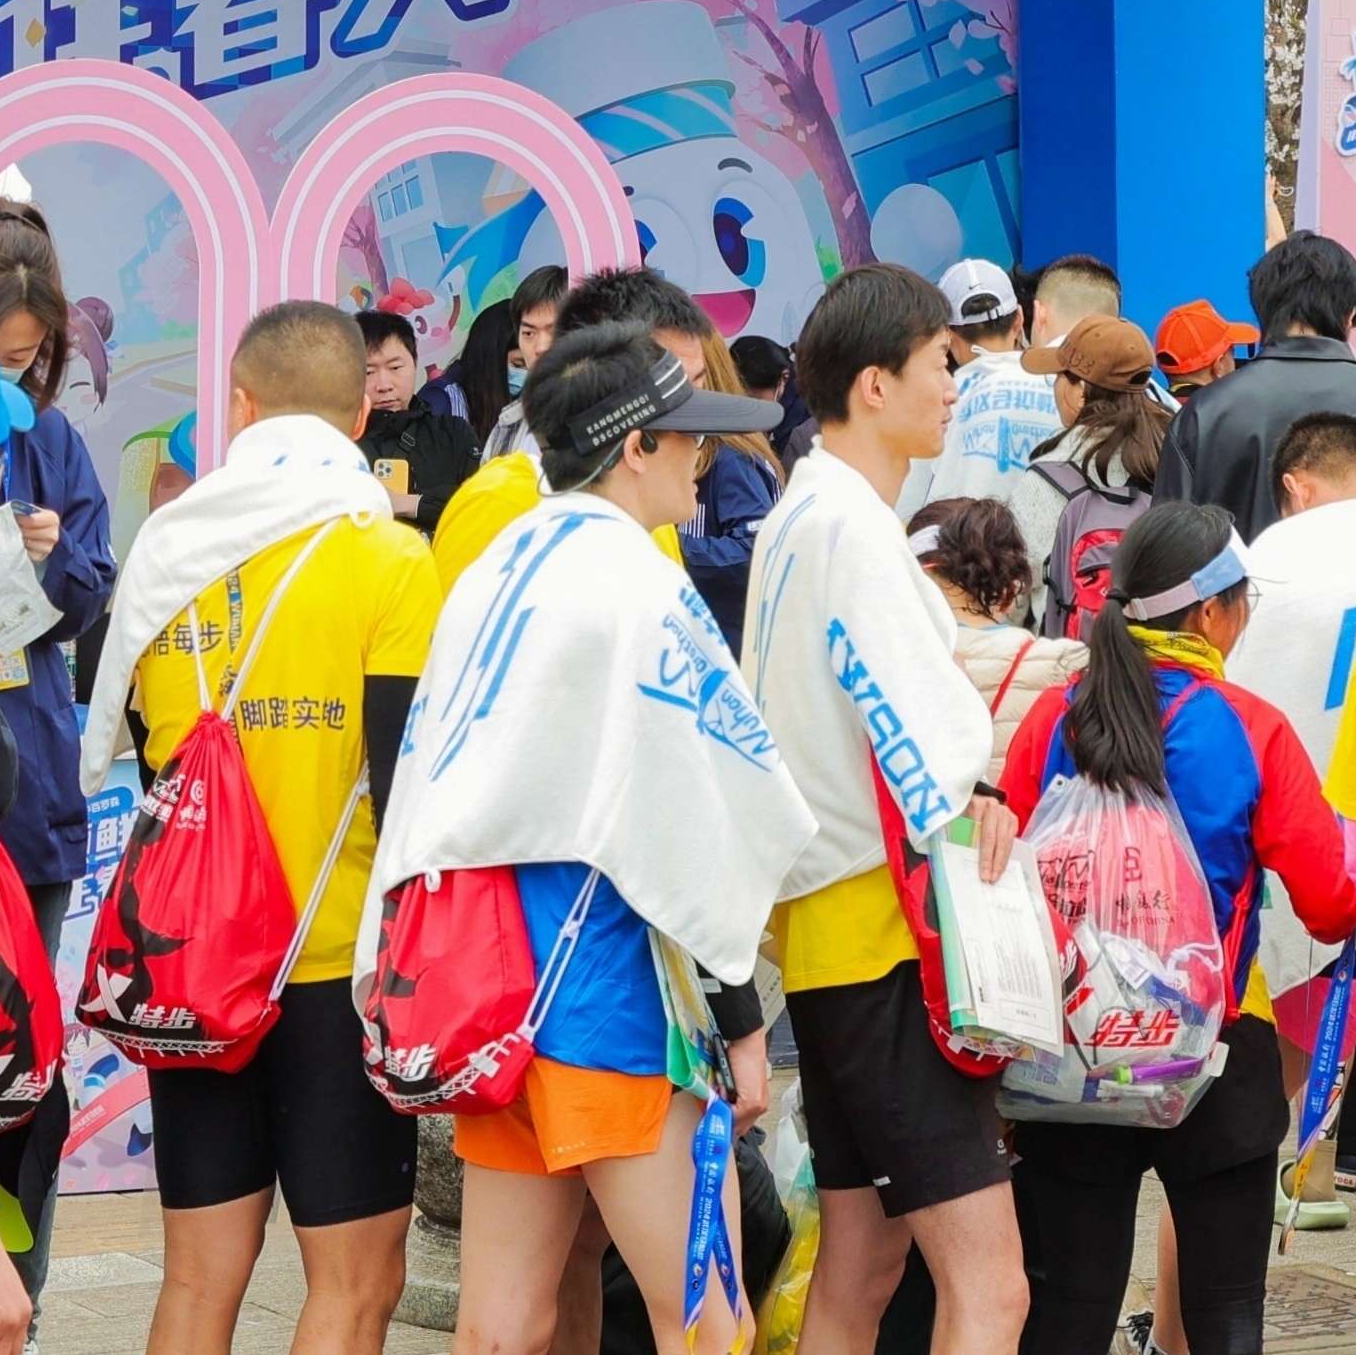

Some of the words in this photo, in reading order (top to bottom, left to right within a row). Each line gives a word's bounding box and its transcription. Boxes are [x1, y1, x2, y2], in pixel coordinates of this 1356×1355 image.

[240, 697, 346, 731] 脚踏实地
[128, 1003, 196, 1030] 特步
[1084, 1009, 1182, 1047] 特步
